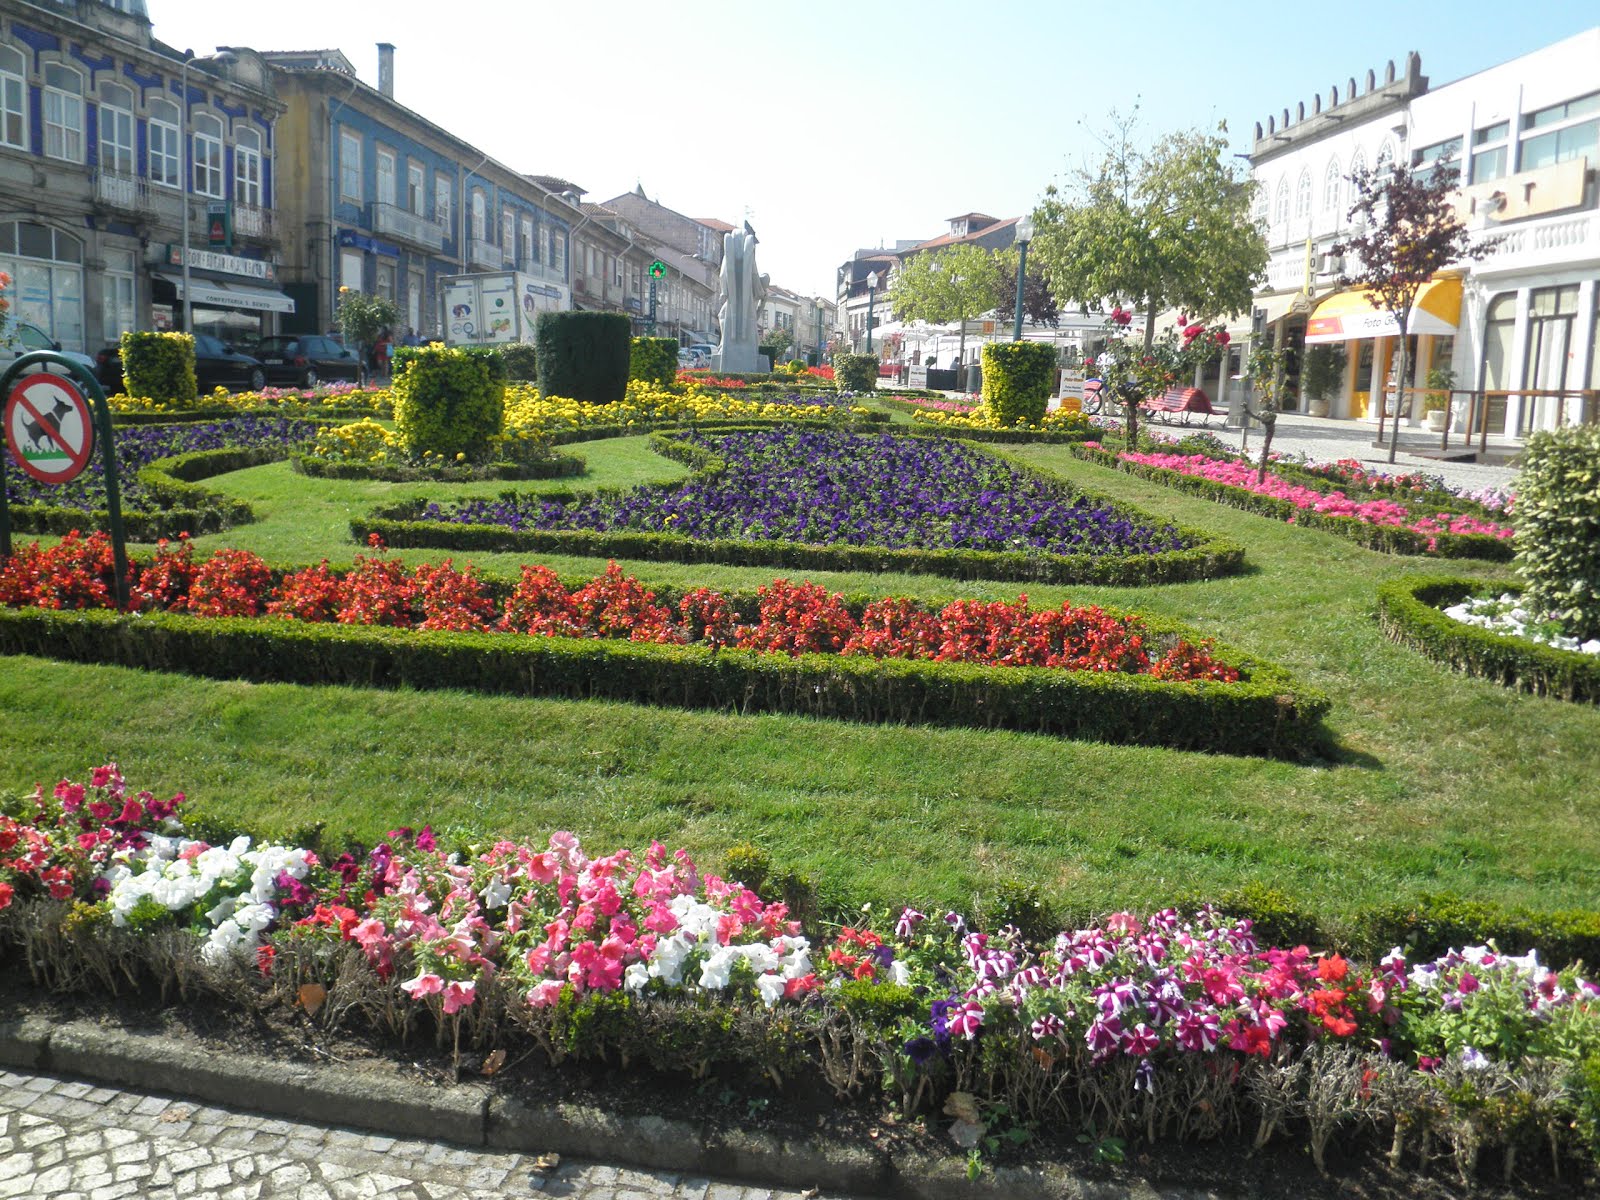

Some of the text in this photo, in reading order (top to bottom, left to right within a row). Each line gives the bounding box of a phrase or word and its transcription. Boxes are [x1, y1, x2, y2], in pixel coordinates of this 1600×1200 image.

[1308, 243, 1316, 297] FOTO
[206, 295, 243, 305] CONFEITARIA
[252, 301, 271, 309] BENTO
[1363, 318, 1381, 328] Foto
